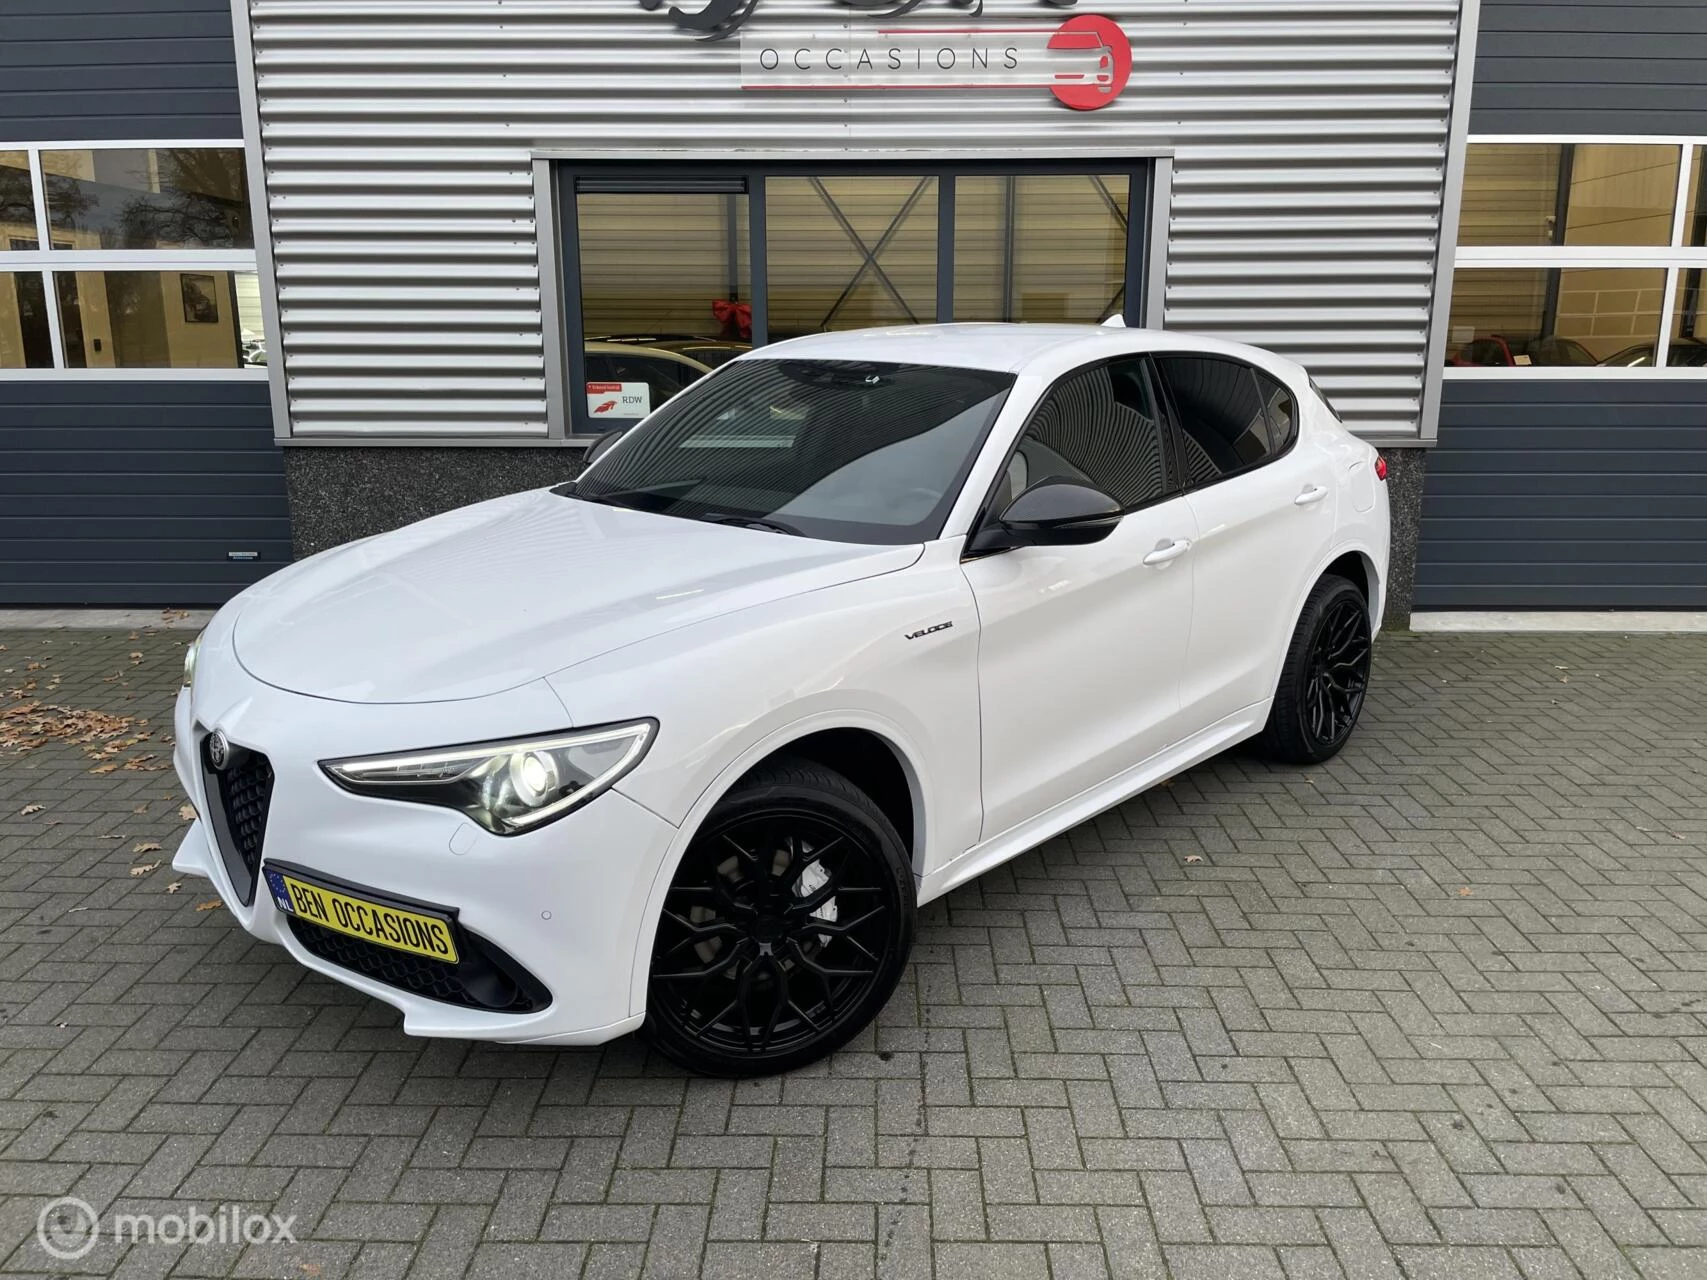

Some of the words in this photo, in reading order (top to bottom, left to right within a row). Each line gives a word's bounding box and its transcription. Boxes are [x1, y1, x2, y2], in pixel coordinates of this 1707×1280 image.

[759, 47, 1019, 70] OCCASIONS
[622, 396, 643, 404] RDW
[904, 621, 953, 640] VELOCE
[277, 896, 294, 912] NL
[290, 883, 330, 922] BEN
[331, 898, 449, 954] OCCASIONS
